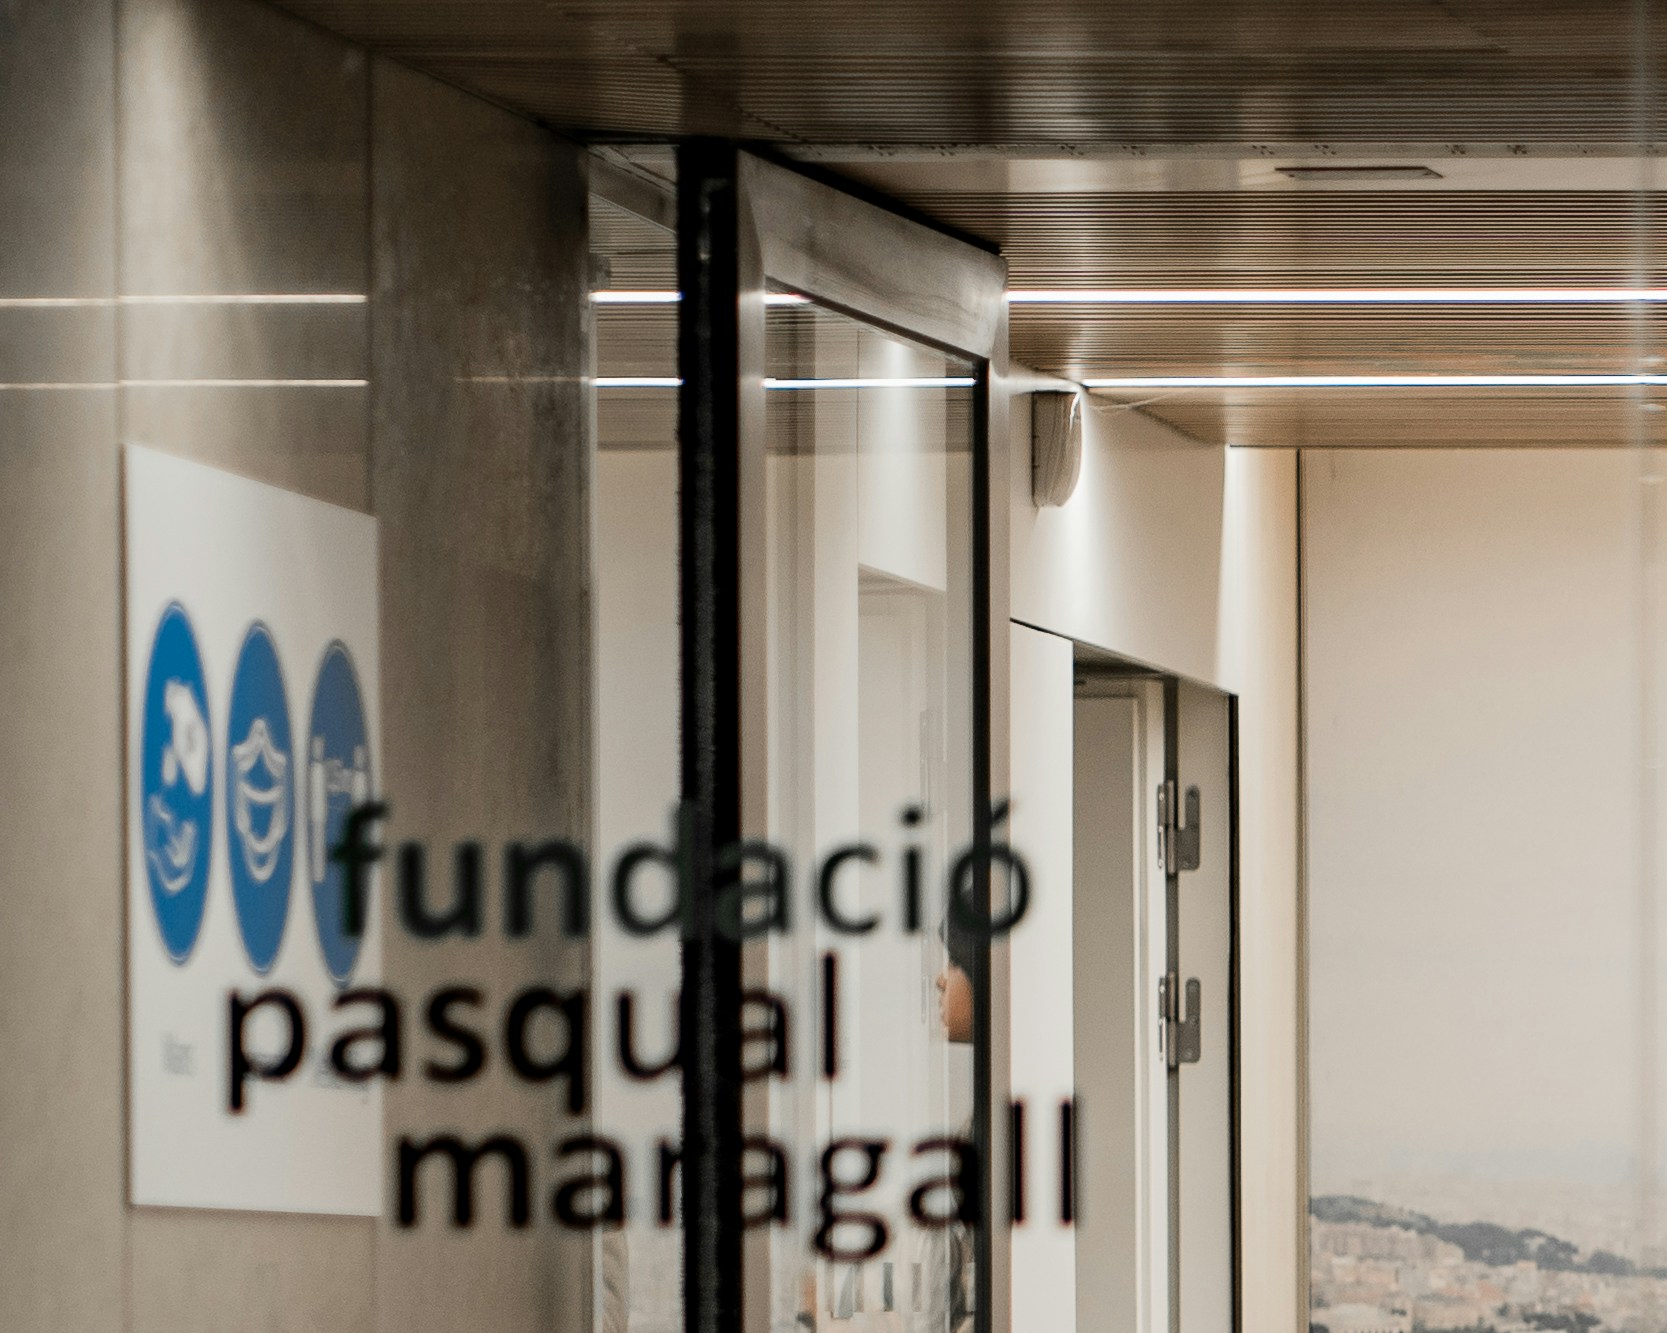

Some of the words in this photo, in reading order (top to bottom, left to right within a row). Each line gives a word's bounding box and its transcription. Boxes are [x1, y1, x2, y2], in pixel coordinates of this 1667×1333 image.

[328, 796, 1032, 942] fundació
[227, 946, 838, 1114] pasqual
[395, 1099, 1074, 1264] maragall
